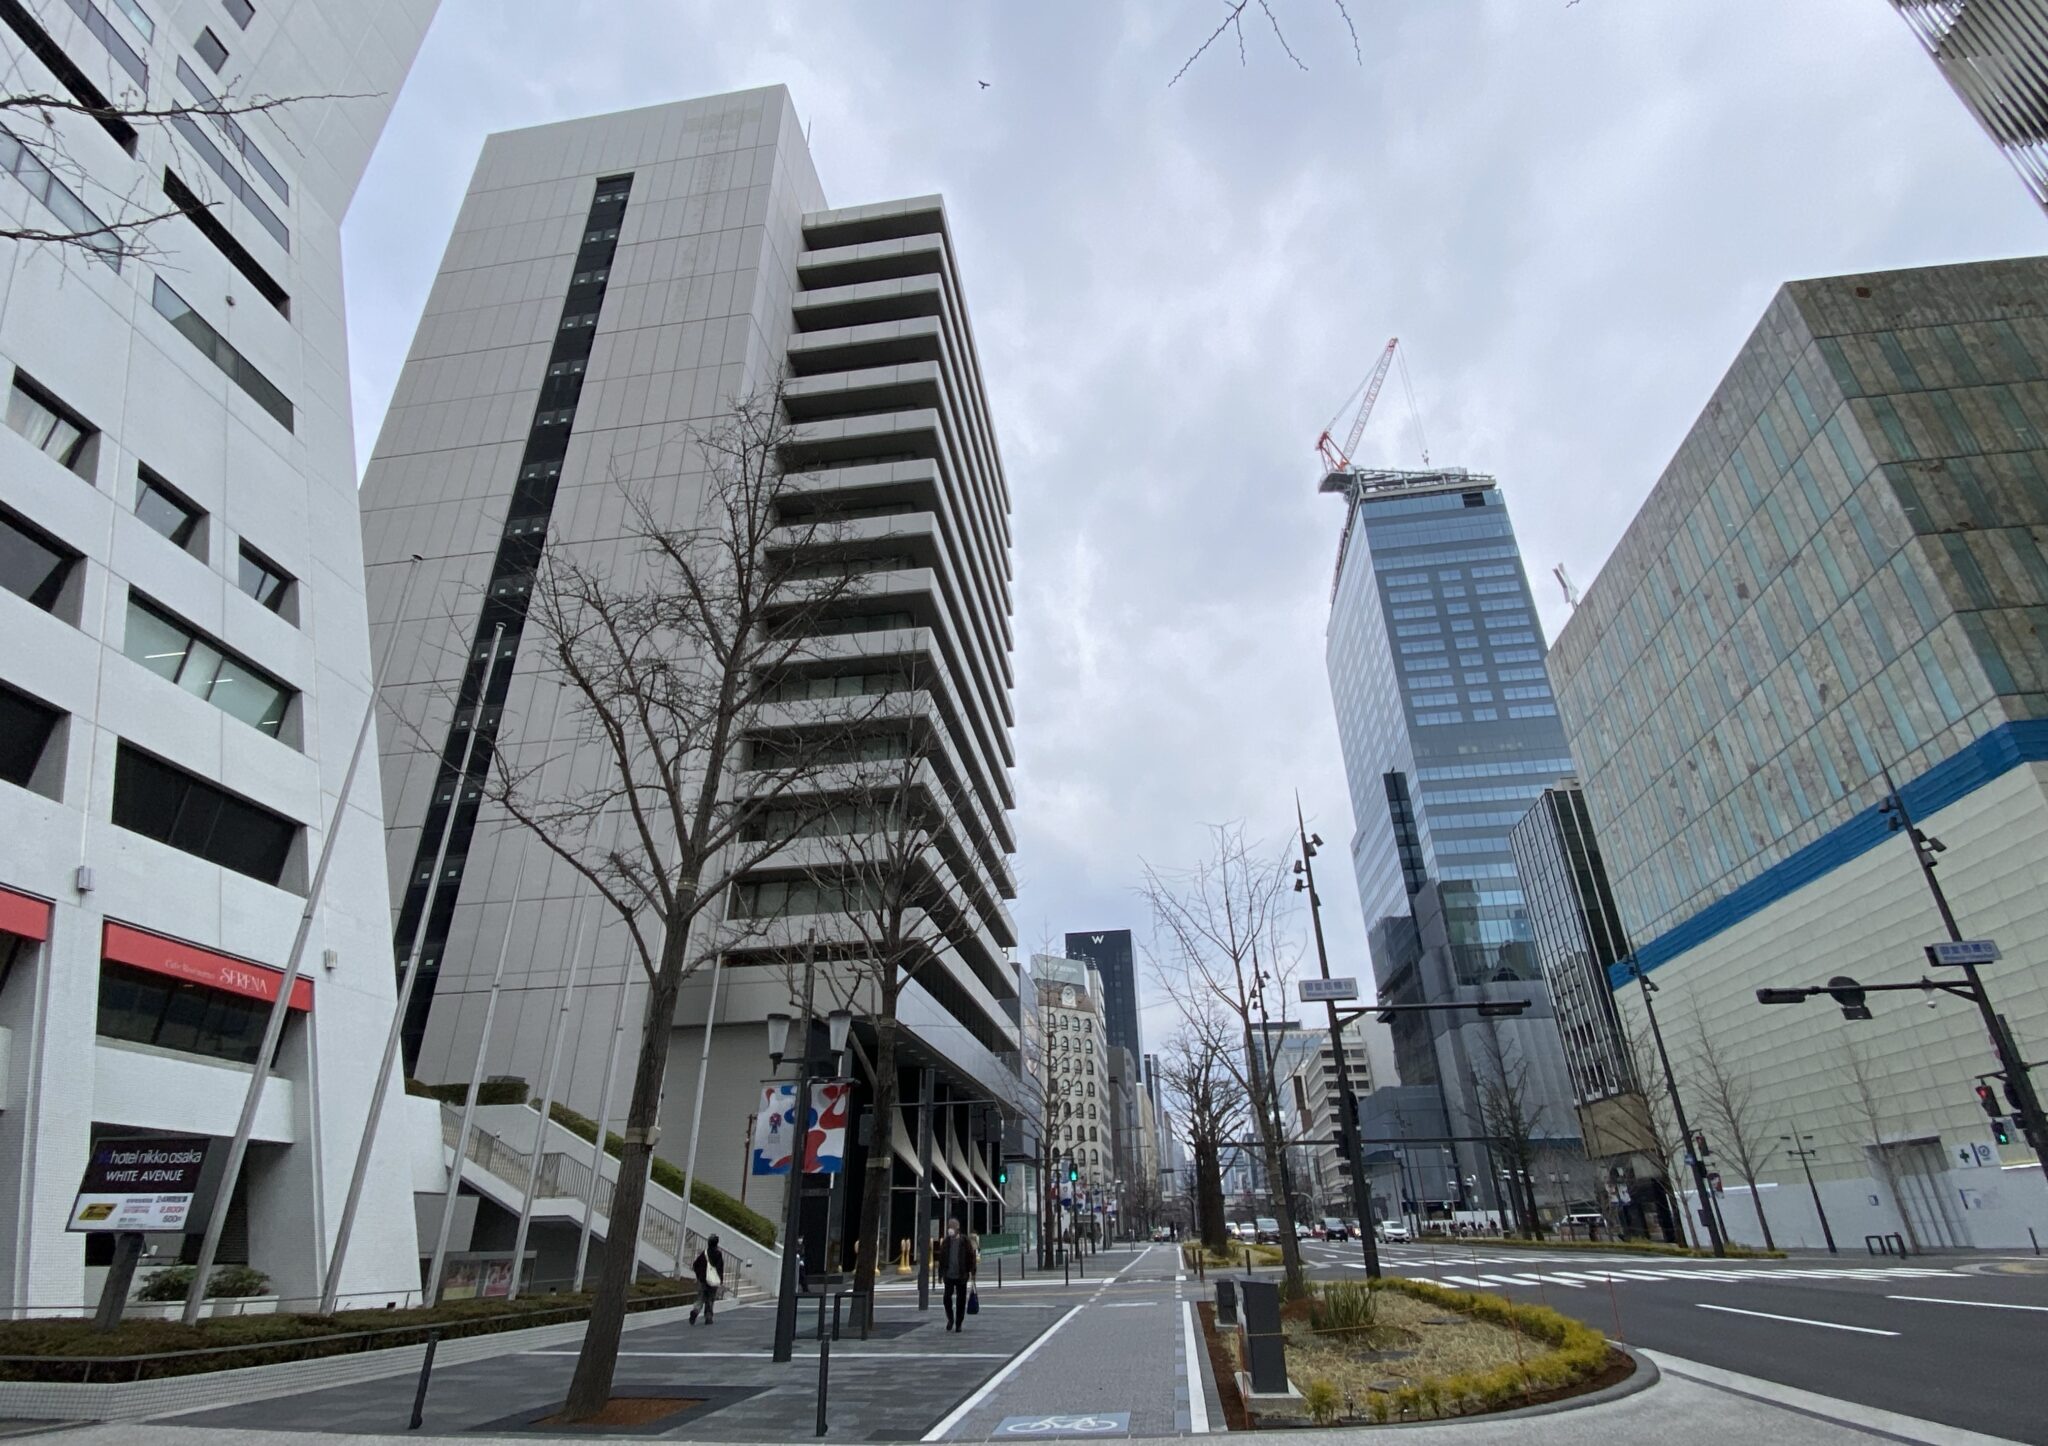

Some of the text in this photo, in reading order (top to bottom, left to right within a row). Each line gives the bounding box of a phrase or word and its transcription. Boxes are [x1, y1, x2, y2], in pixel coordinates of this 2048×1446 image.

[1091, 934, 1104, 945] W
[220, 967, 268, 994] SERENA
[110, 1149, 202, 1164] hotel nikko osaka
[106, 1169, 184, 1181] WHITE AVENUE
